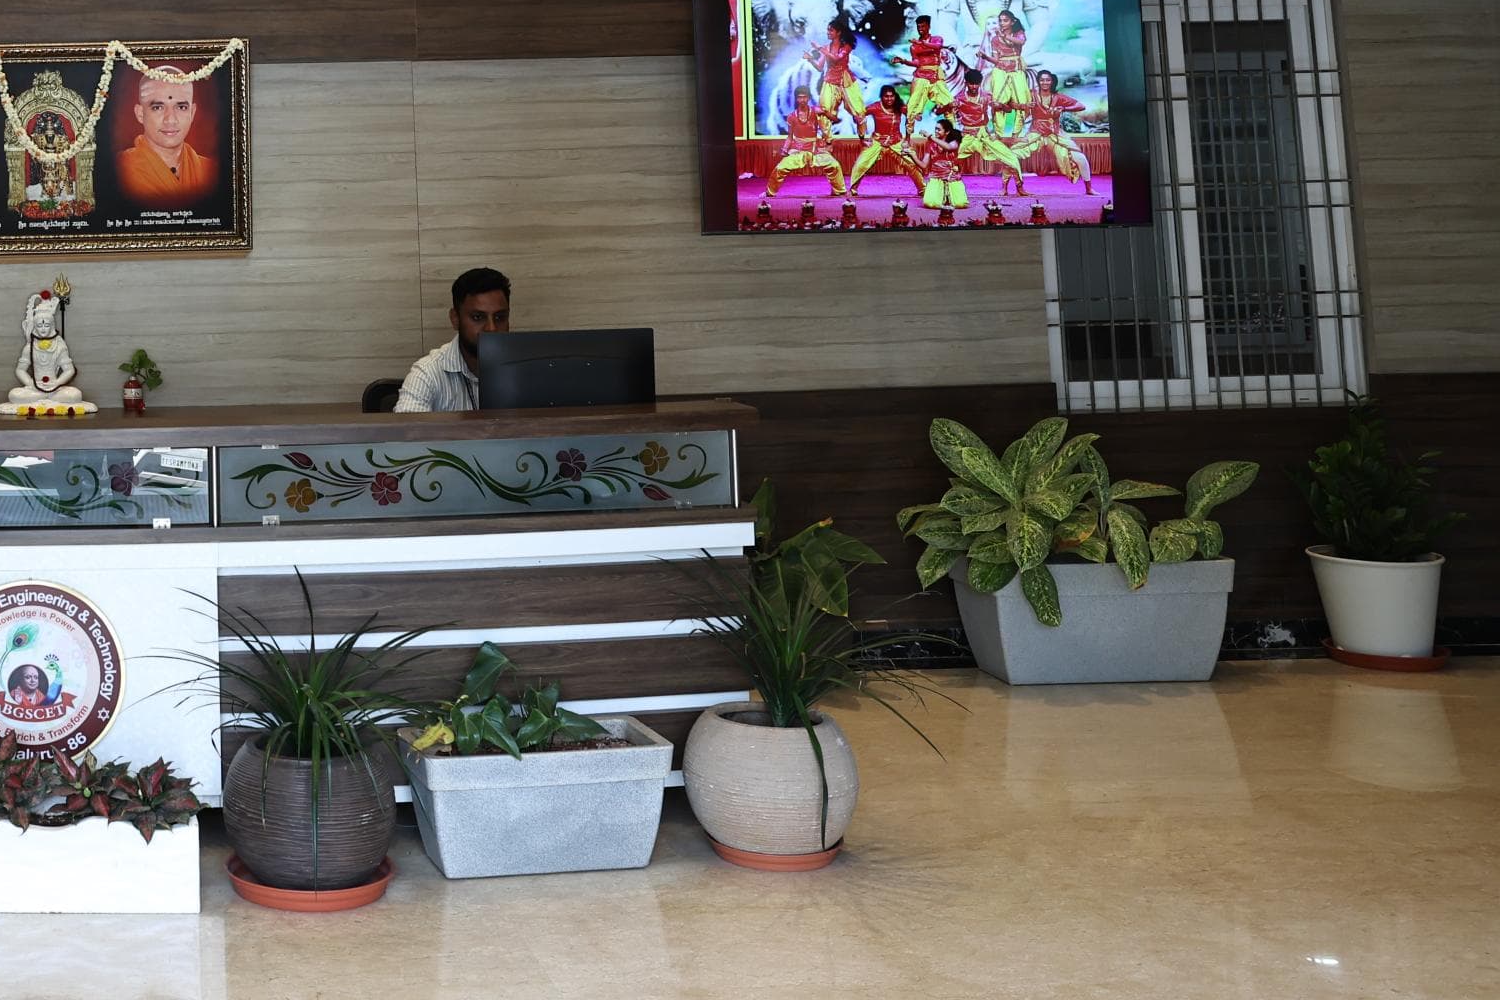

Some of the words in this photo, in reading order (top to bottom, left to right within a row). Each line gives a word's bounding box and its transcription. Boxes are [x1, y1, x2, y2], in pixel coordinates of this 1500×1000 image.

[39, 610, 48, 618] is
[49, 612, 76, 633] Power
[0, 589, 79, 617] Engineering
[77, 611, 89, 623] &
[88, 619, 116, 701] Technology
[2, 704, 64, 719] BGSCET
[4, 727, 35, 741] Erich
[38, 733, 46, 741] &
[47, 705, 88, 738] Transform
[67, 732, 87, 750] 86
